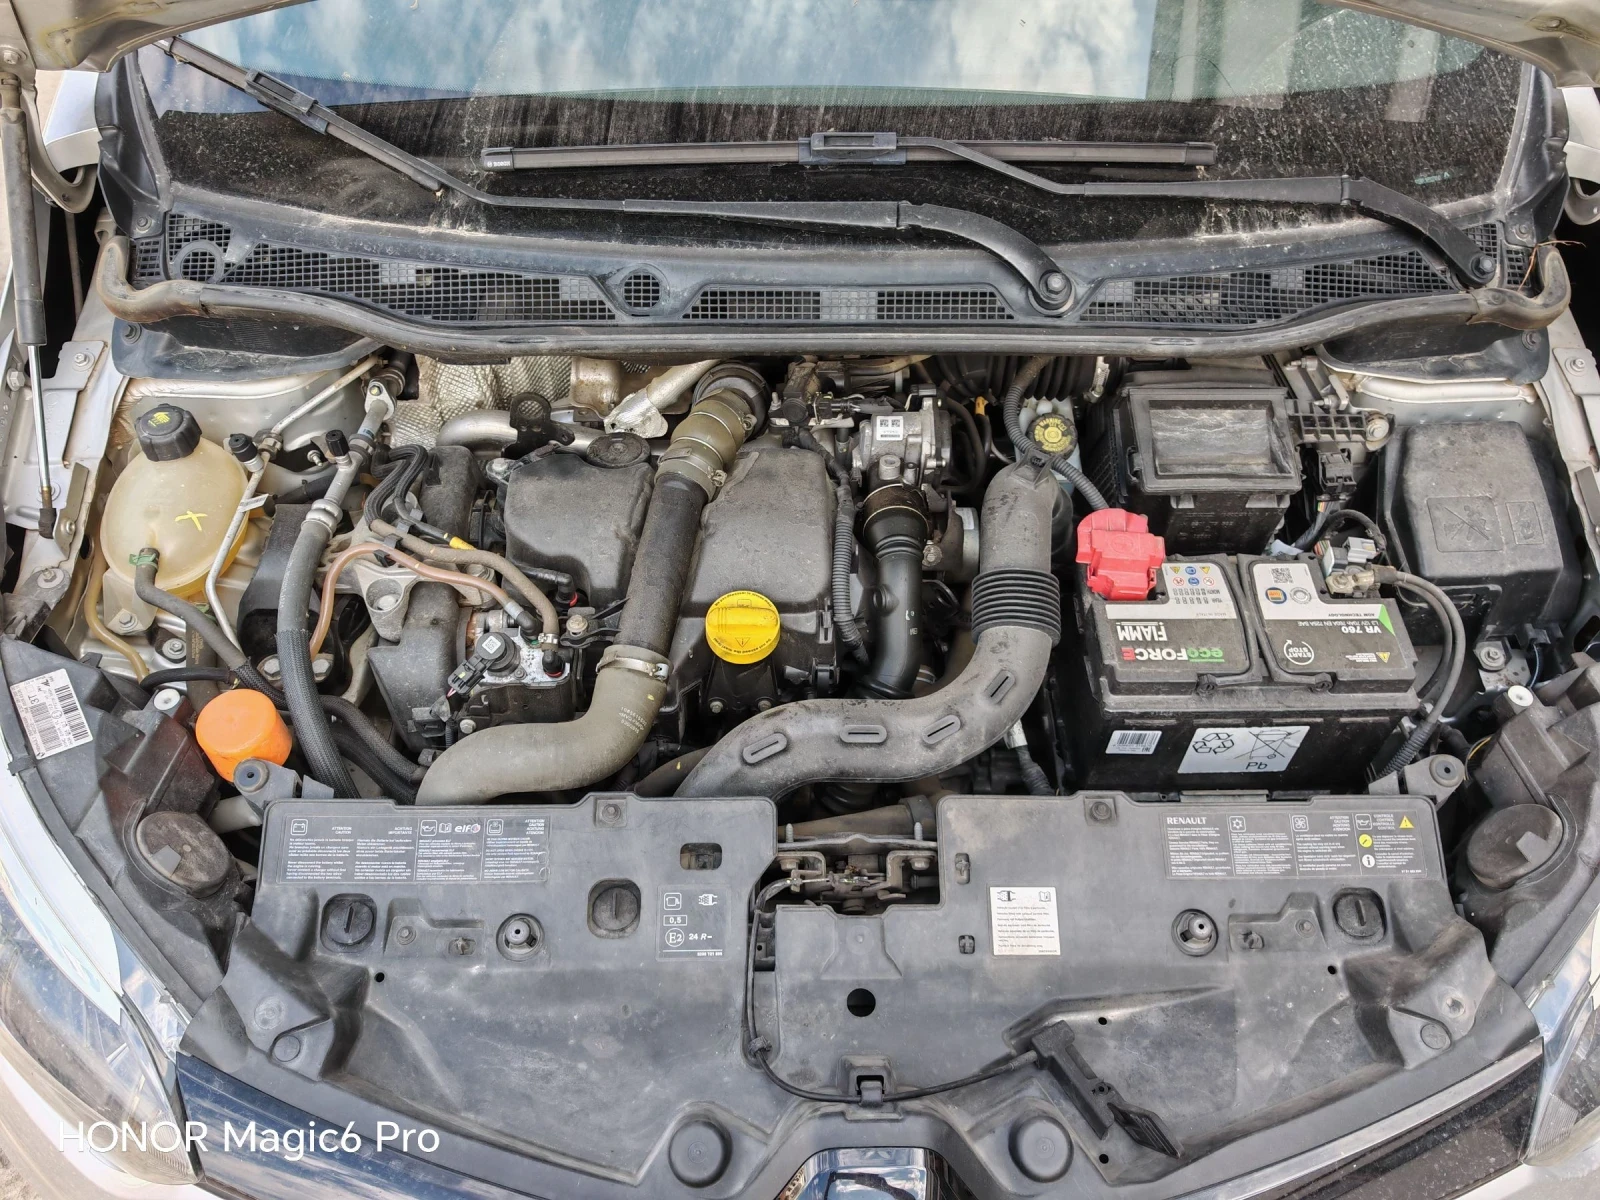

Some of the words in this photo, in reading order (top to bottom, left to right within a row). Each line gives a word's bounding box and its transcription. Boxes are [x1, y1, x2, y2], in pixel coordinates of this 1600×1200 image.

[1116, 625, 1168, 641] FIAMM
[1341, 625, 1363, 634] 760
[1364, 625, 1382, 634] VR
[1121, 647, 1224, 661] ecoFORCE
[1245, 761, 1268, 770] Pb
[1166, 816, 1207, 825] RENAULT
[454, 823, 472, 832] elf
[669, 916, 682, 924] 0,5
[669, 932, 682, 944] E2
